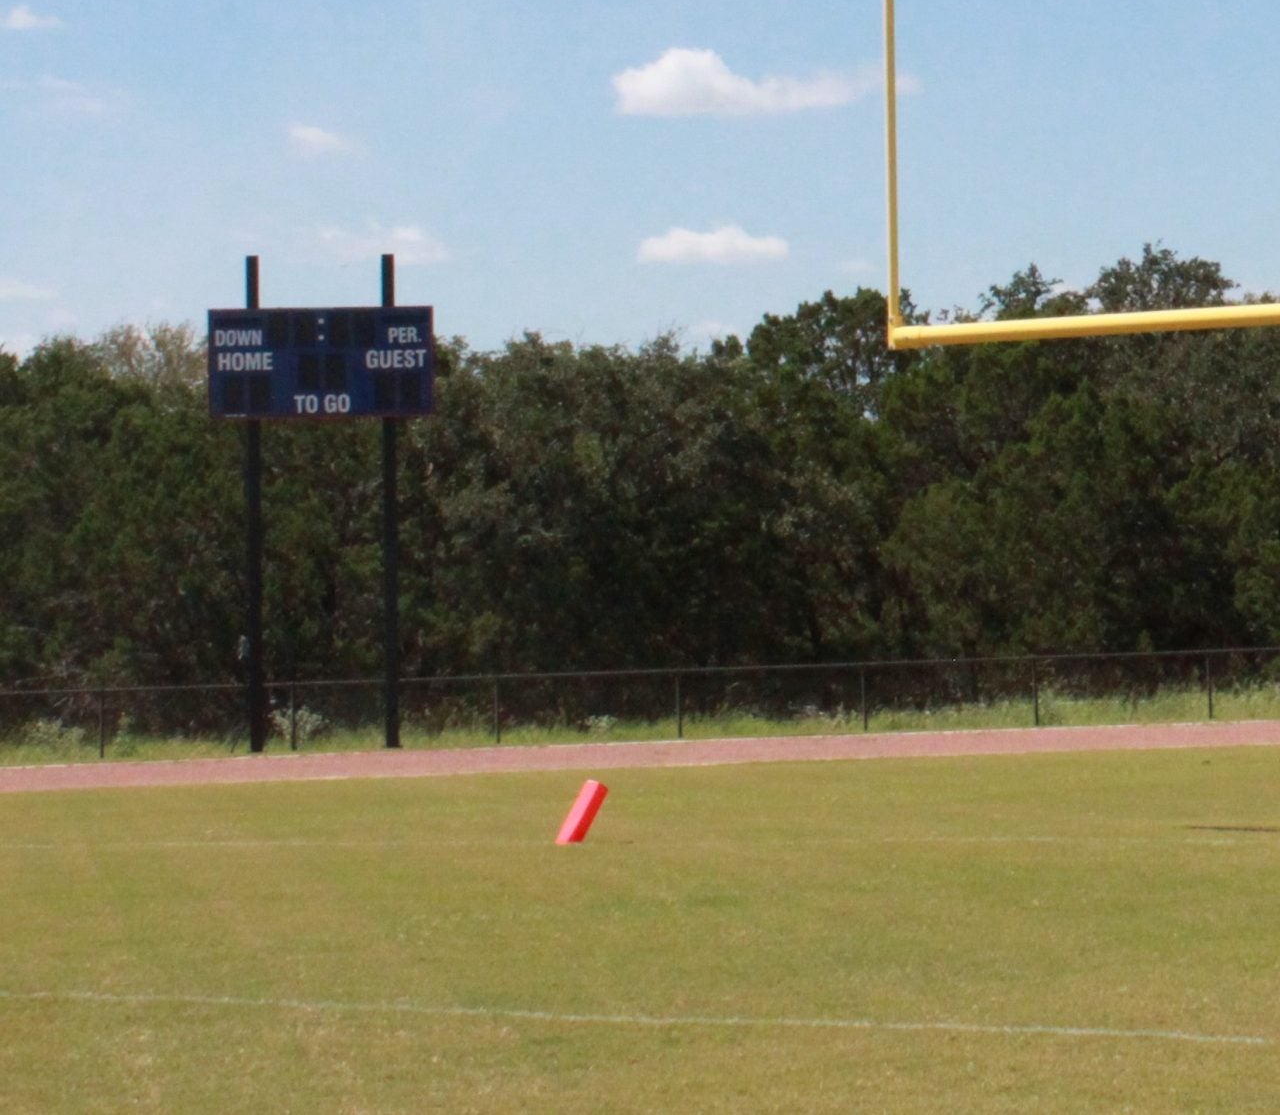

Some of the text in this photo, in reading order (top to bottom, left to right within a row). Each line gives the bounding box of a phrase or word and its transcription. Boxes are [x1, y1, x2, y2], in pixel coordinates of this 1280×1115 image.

[215, 330, 262, 347] DOWN
[388, 327, 422, 344] PER.
[218, 352, 273, 371] HOME
[365, 349, 427, 369] GUEST
[294, 394, 351, 414] TO GO
